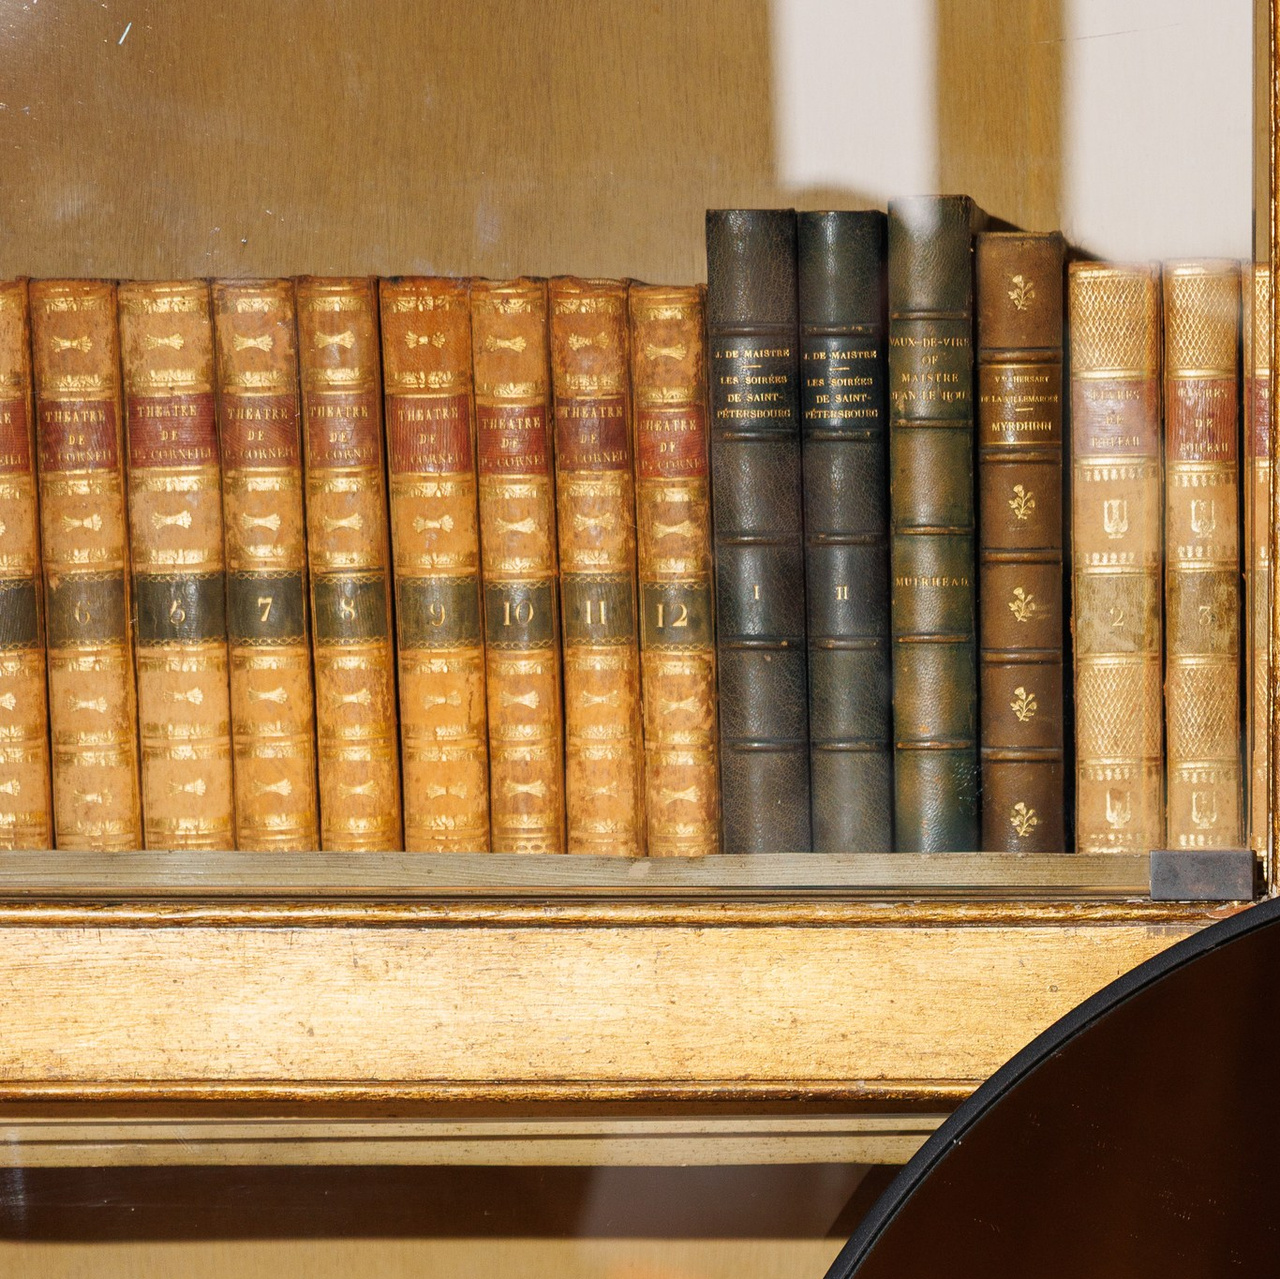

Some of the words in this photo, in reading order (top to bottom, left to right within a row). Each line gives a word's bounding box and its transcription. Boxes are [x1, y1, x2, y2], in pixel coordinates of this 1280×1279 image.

[715, 350, 723, 359] J.
[725, 350, 739, 359] DE
[744, 349, 790, 358] MAISTRE
[803, 352, 810, 360] J.
[813, 352, 827, 360] DE
[831, 350, 877, 359] MAISTRE
[921, 355, 939, 365] OF
[720, 376, 739, 385] LES
[745, 374, 788, 385] SOIRÉES
[807, 378, 825, 387] LES
[830, 375, 873, 386] SOIRÉES
[901, 373, 959, 382] MAISTRE
[727, 393, 742, 403] DE
[746, 392, 784, 402] SAINT-
[816, 394, 830, 404] DE
[835, 393, 872, 403] SAINT-
[716, 407, 791, 419] PÉTERSBOURG
[805, 408, 879, 420] PÉTERSBOURG
[992, 422, 1052, 431] MYRDHINN
[69, 435, 85, 446] DE
[161, 430, 178, 441] DE
[247, 430, 265, 442] DE
[329, 432, 348, 444] DE
[419, 434, 437, 445] DE
[580, 433, 597, 444] DE
[501, 438, 520, 449] DE
[660, 442, 676, 453] DE
[896, 577, 969, 587] MUIRHEAD
[836, 586, 848, 600] II
[257, 596, 273, 622] 7
[340, 598, 356, 621] 8
[503, 600, 534, 626] 10
[585, 600, 606, 625] 11
[430, 603, 446, 627] 9
[657, 603, 688, 628] 12
[1110, 607, 1124, 627] 2
[1199, 605, 1211, 626] 3
